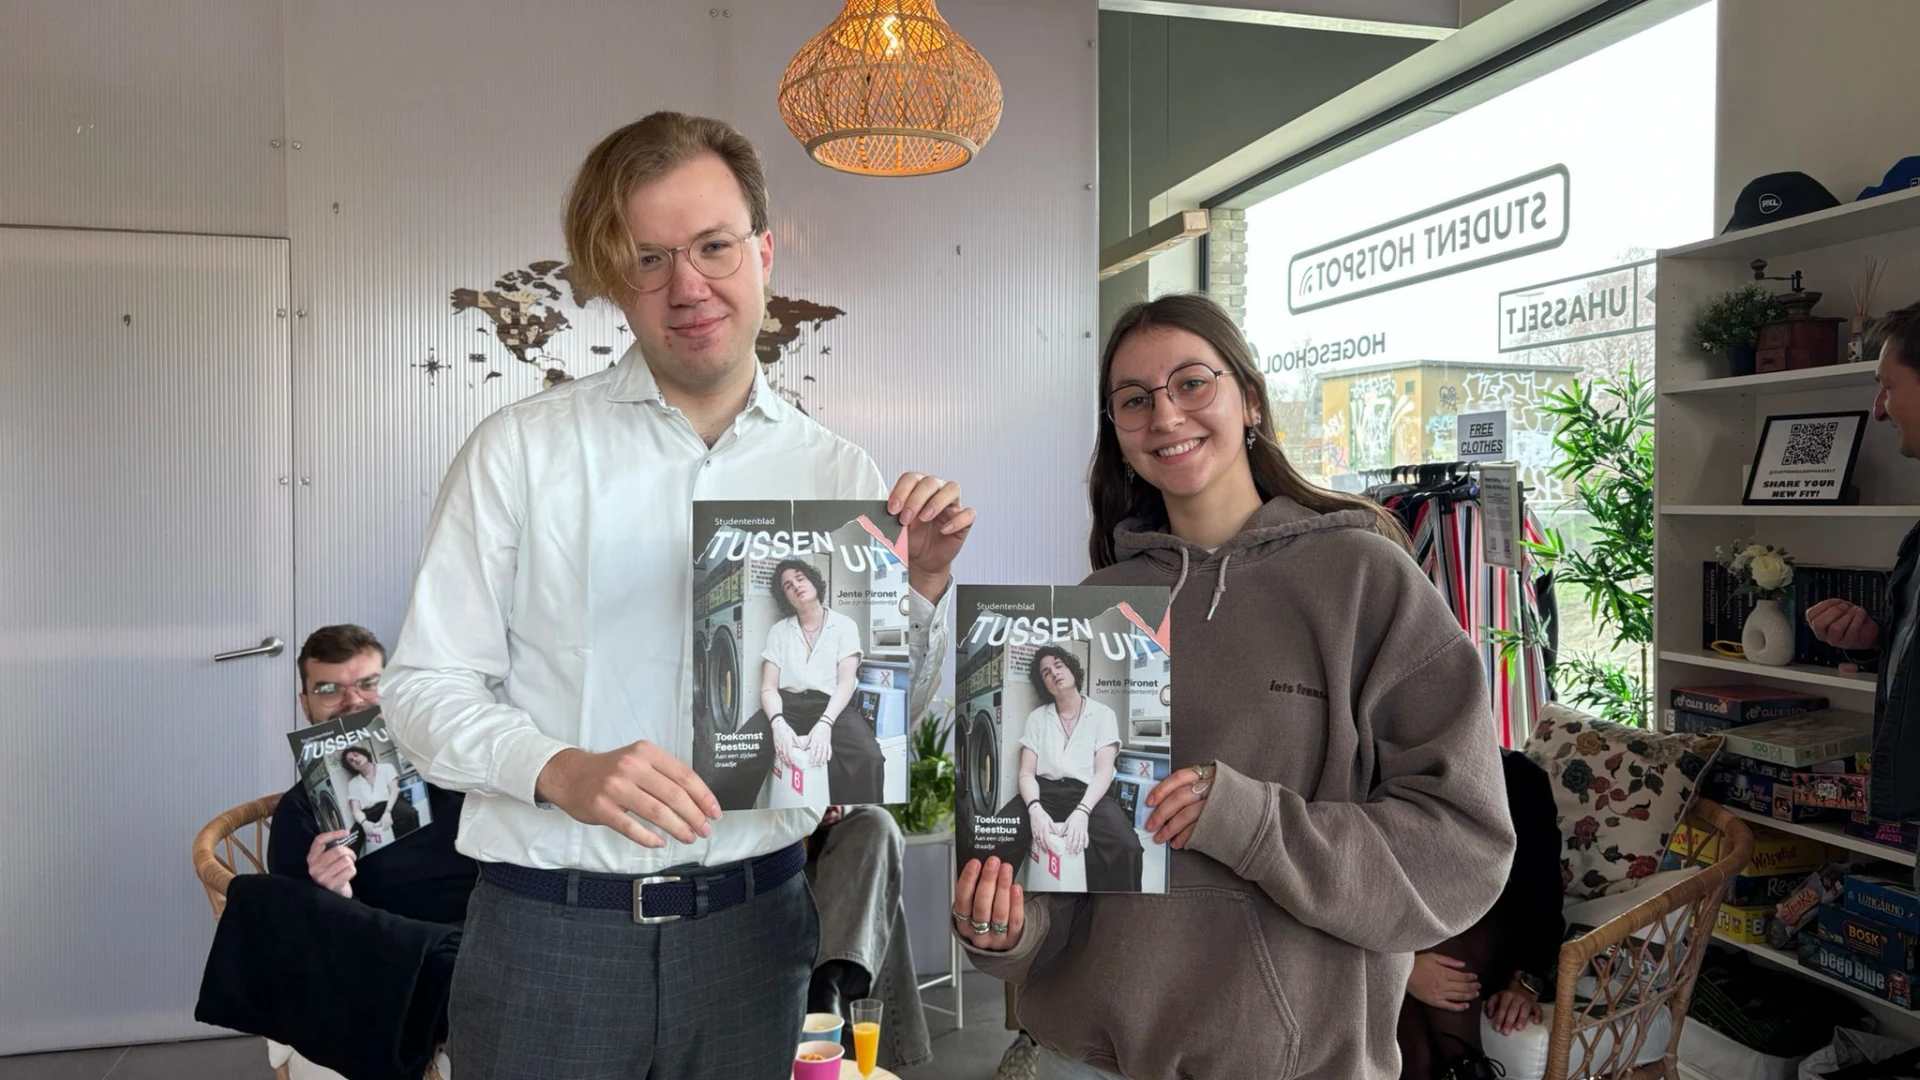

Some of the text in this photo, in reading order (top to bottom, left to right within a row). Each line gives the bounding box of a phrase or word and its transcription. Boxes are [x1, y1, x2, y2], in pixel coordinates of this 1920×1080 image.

[1762, 199, 1779, 208] PXL
[1470, 422, 1494, 435] FREE
[1460, 439, 1503, 453] CLOTHES
[1763, 480, 1801, 488] SHARE
[1772, 490, 1820, 498] NEW FIT!
[714, 517, 776, 526] Studentenblad
[708, 530, 895, 572] TUSSEN UIT
[837, 590, 897, 598] Jente Pironet
[976, 602, 1035, 611] Studentenblad
[970, 616, 1156, 661] TUSSEN UIT
[1096, 678, 1158, 687] Jente Pironet
[714, 732, 764, 741] Toekomst
[303, 727, 371, 760] TUSSEN
[715, 742, 760, 752] Feestbus
[974, 815, 1021, 824] Toekomst
[974, 825, 1018, 834] Feestbus
[1848, 924, 1880, 948] BOSK
[1820, 948, 1853, 978] Deep
[1854, 961, 1886, 990] Blue
